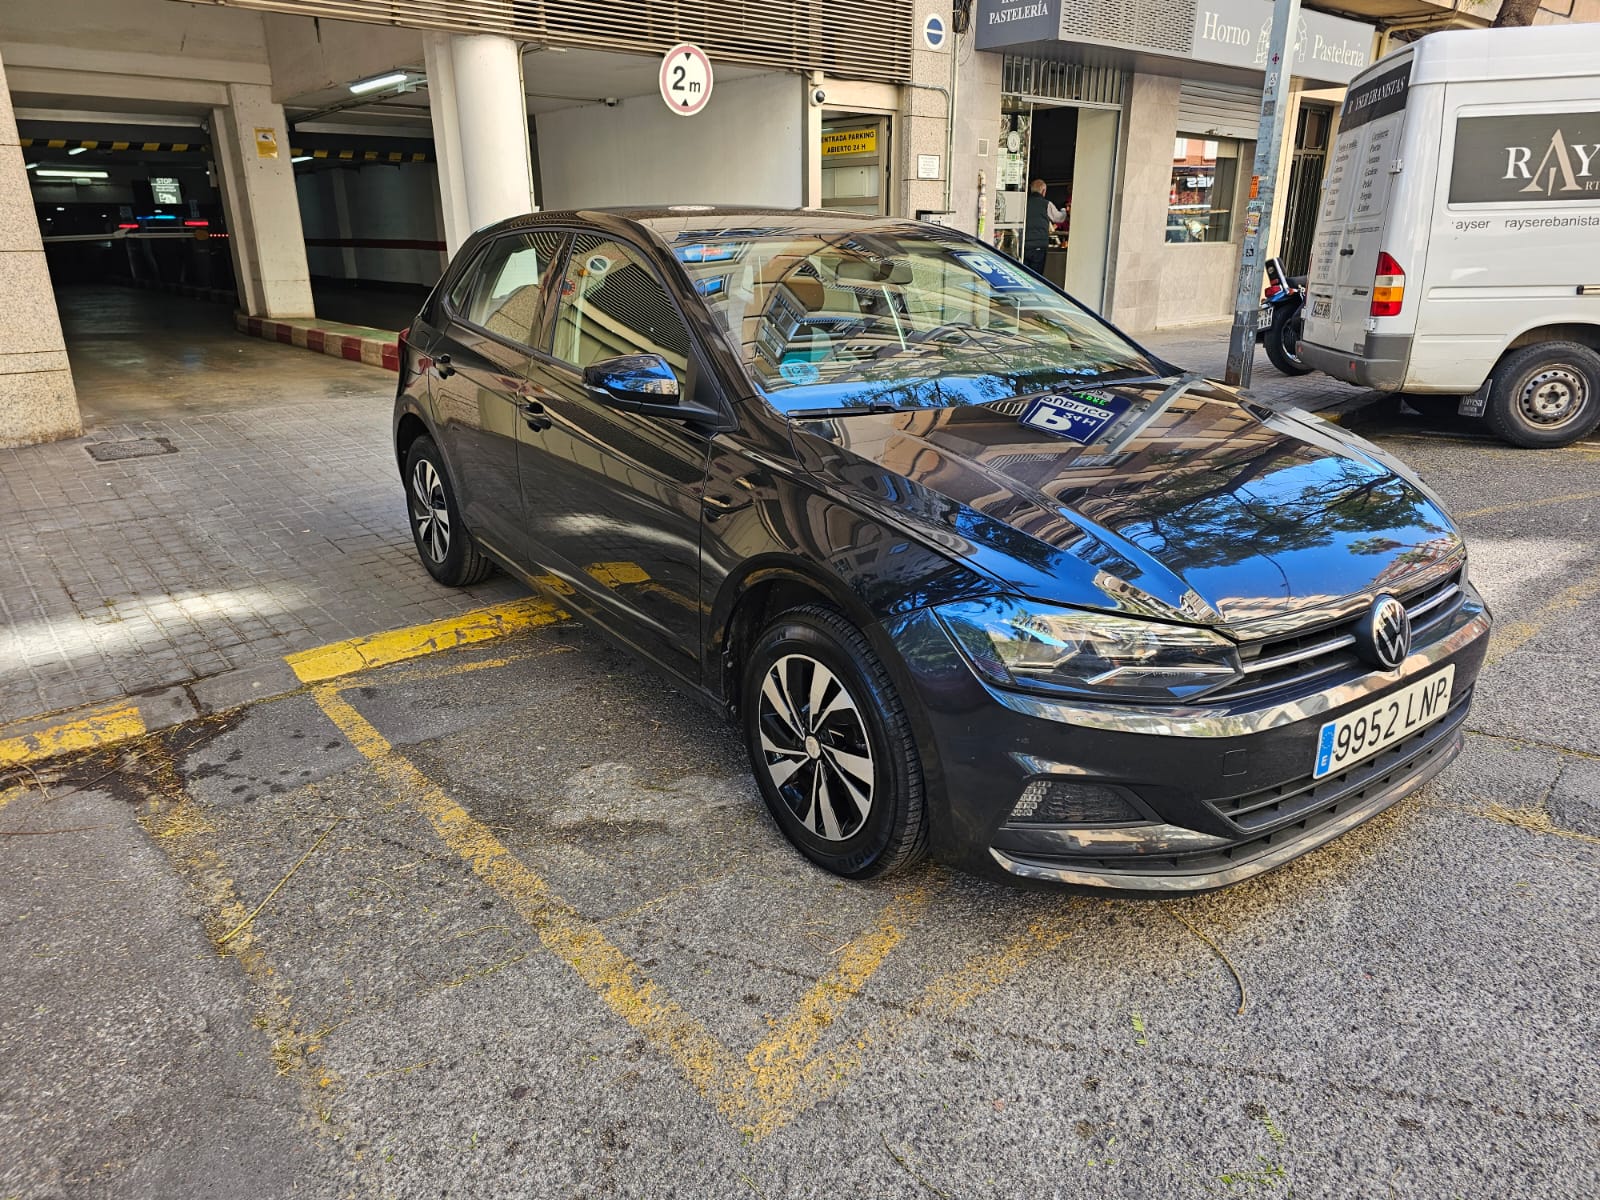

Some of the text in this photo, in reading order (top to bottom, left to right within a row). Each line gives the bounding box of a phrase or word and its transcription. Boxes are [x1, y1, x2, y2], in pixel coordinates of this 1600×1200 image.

[989, 1, 1048, 24] PASTELERÍA
[1202, 12, 1250, 46] Horno
[672, 65, 701, 92] 2 m
[848, 131, 875, 140] PARKING
[827, 145, 852, 153] ABIERTO
[1334, 676, 1447, 762] 9952 LNP
[1320, 754, 1328, 768] E
